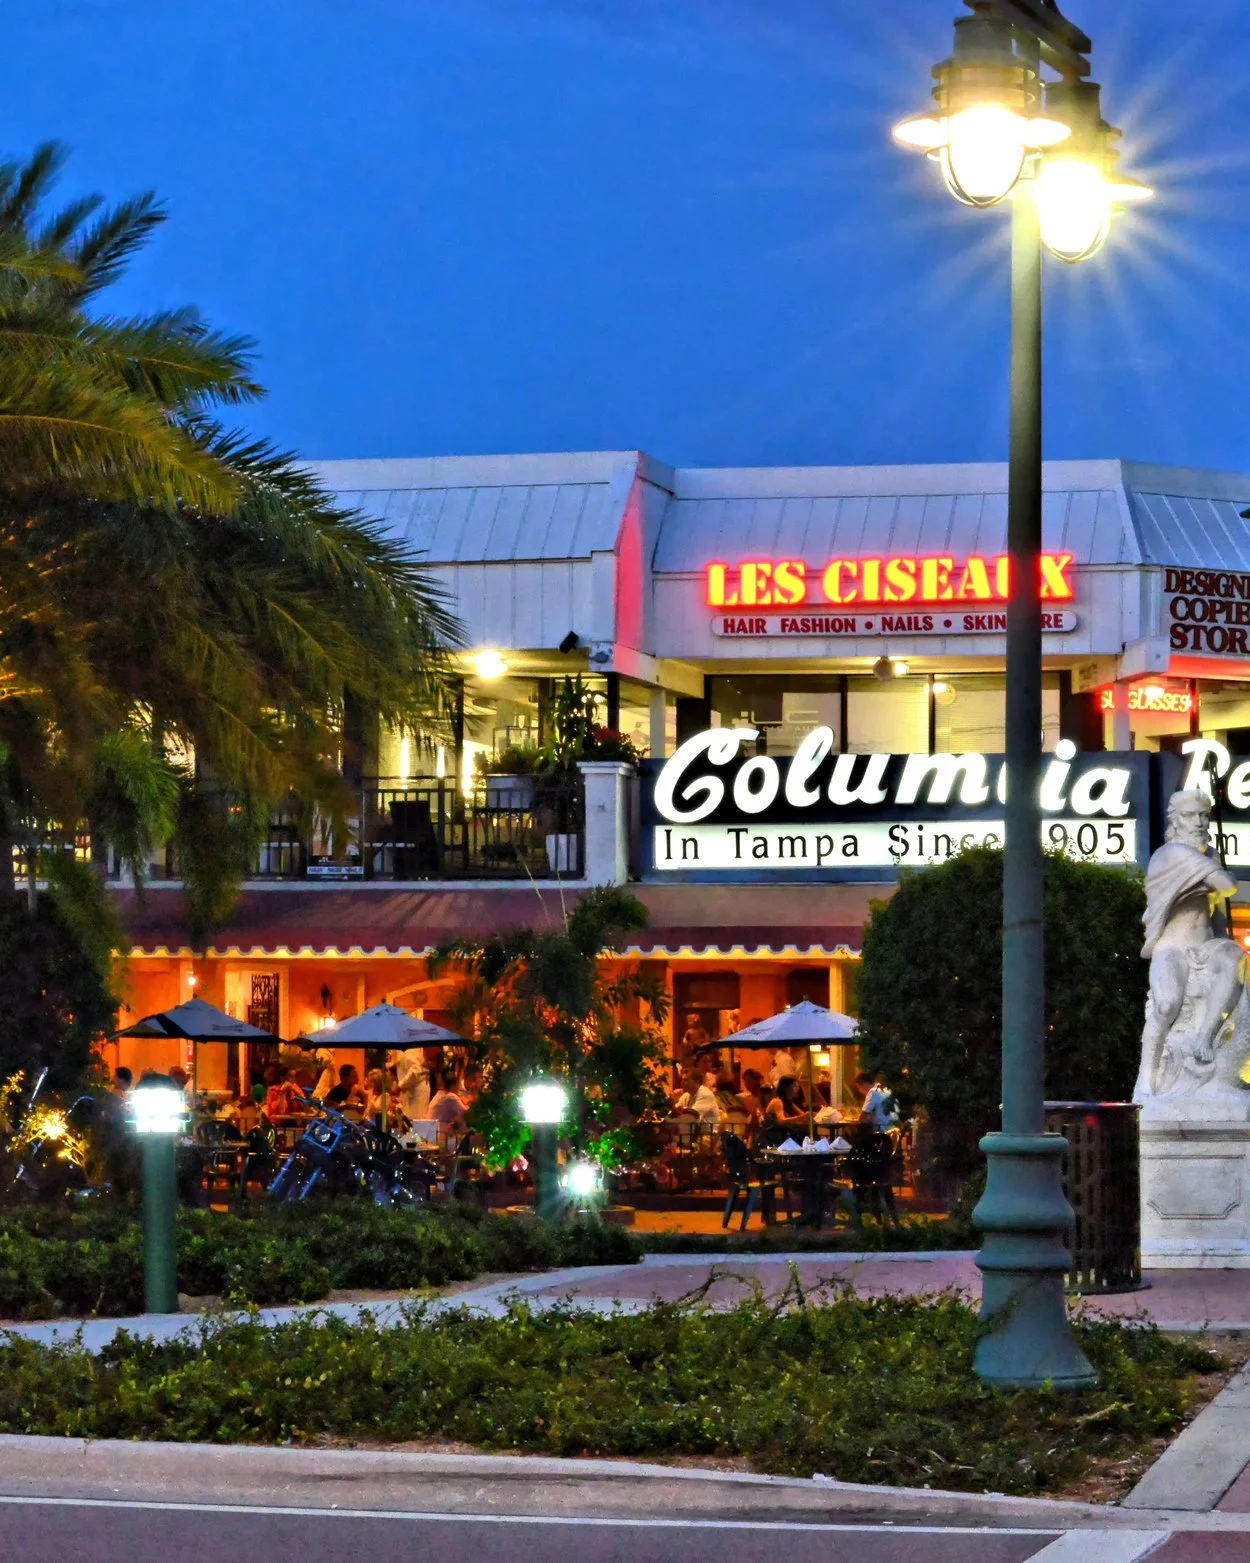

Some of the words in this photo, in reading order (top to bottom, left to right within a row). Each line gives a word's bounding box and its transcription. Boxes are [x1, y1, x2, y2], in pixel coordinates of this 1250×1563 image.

[708, 561, 806, 606] LES
[822, 554, 1073, 603] CISEAX
[723, 618, 767, 633] HAIR
[780, 617, 856, 633] FASHION
[881, 616, 934, 632] NAILS
[963, 615, 1006, 630] SKIN
[654, 726, 1131, 824] Columia
[664, 828, 700, 860] In
[727, 828, 860, 866] Tampa
[1048, 822, 1125, 855] 905
